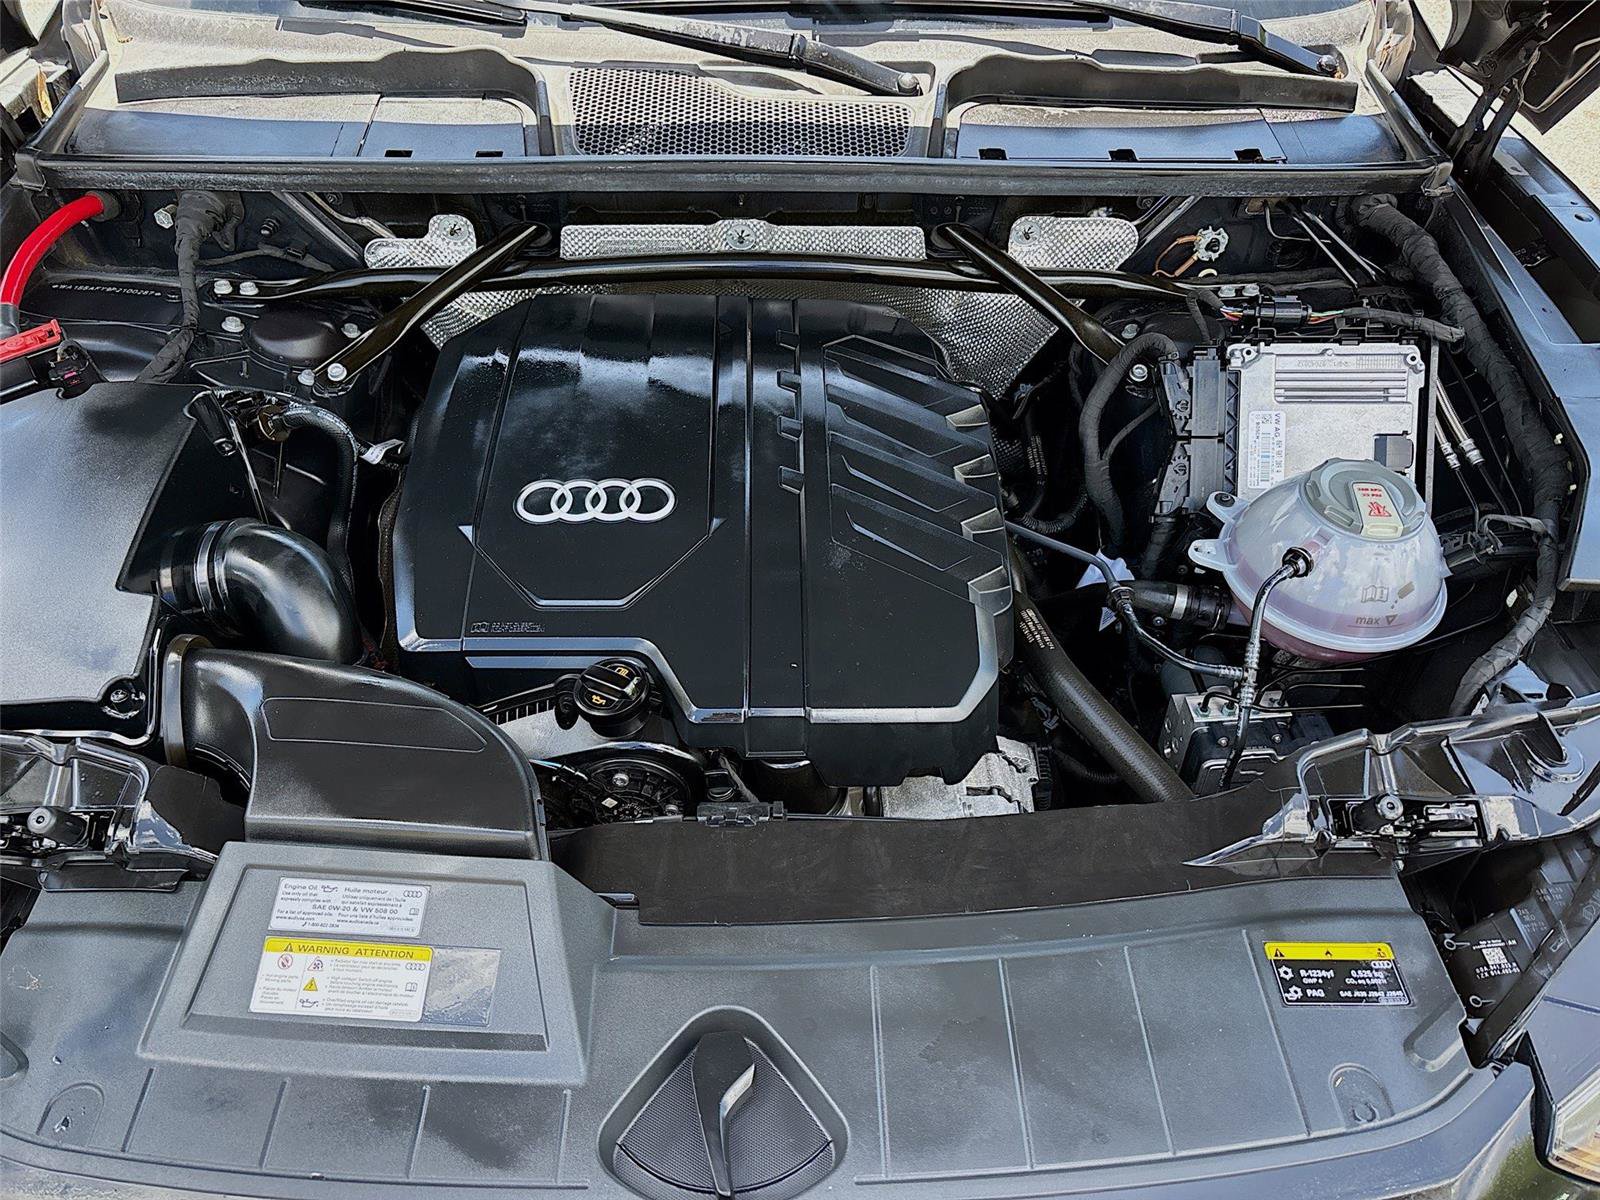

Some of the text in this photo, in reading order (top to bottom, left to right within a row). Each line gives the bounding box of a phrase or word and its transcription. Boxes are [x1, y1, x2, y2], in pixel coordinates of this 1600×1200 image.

[1274, 413, 1281, 426] VW
[1356, 616, 1380, 625] max
[298, 945, 414, 959] WARNING ATTENTION
[1306, 989, 1325, 997] PAG
